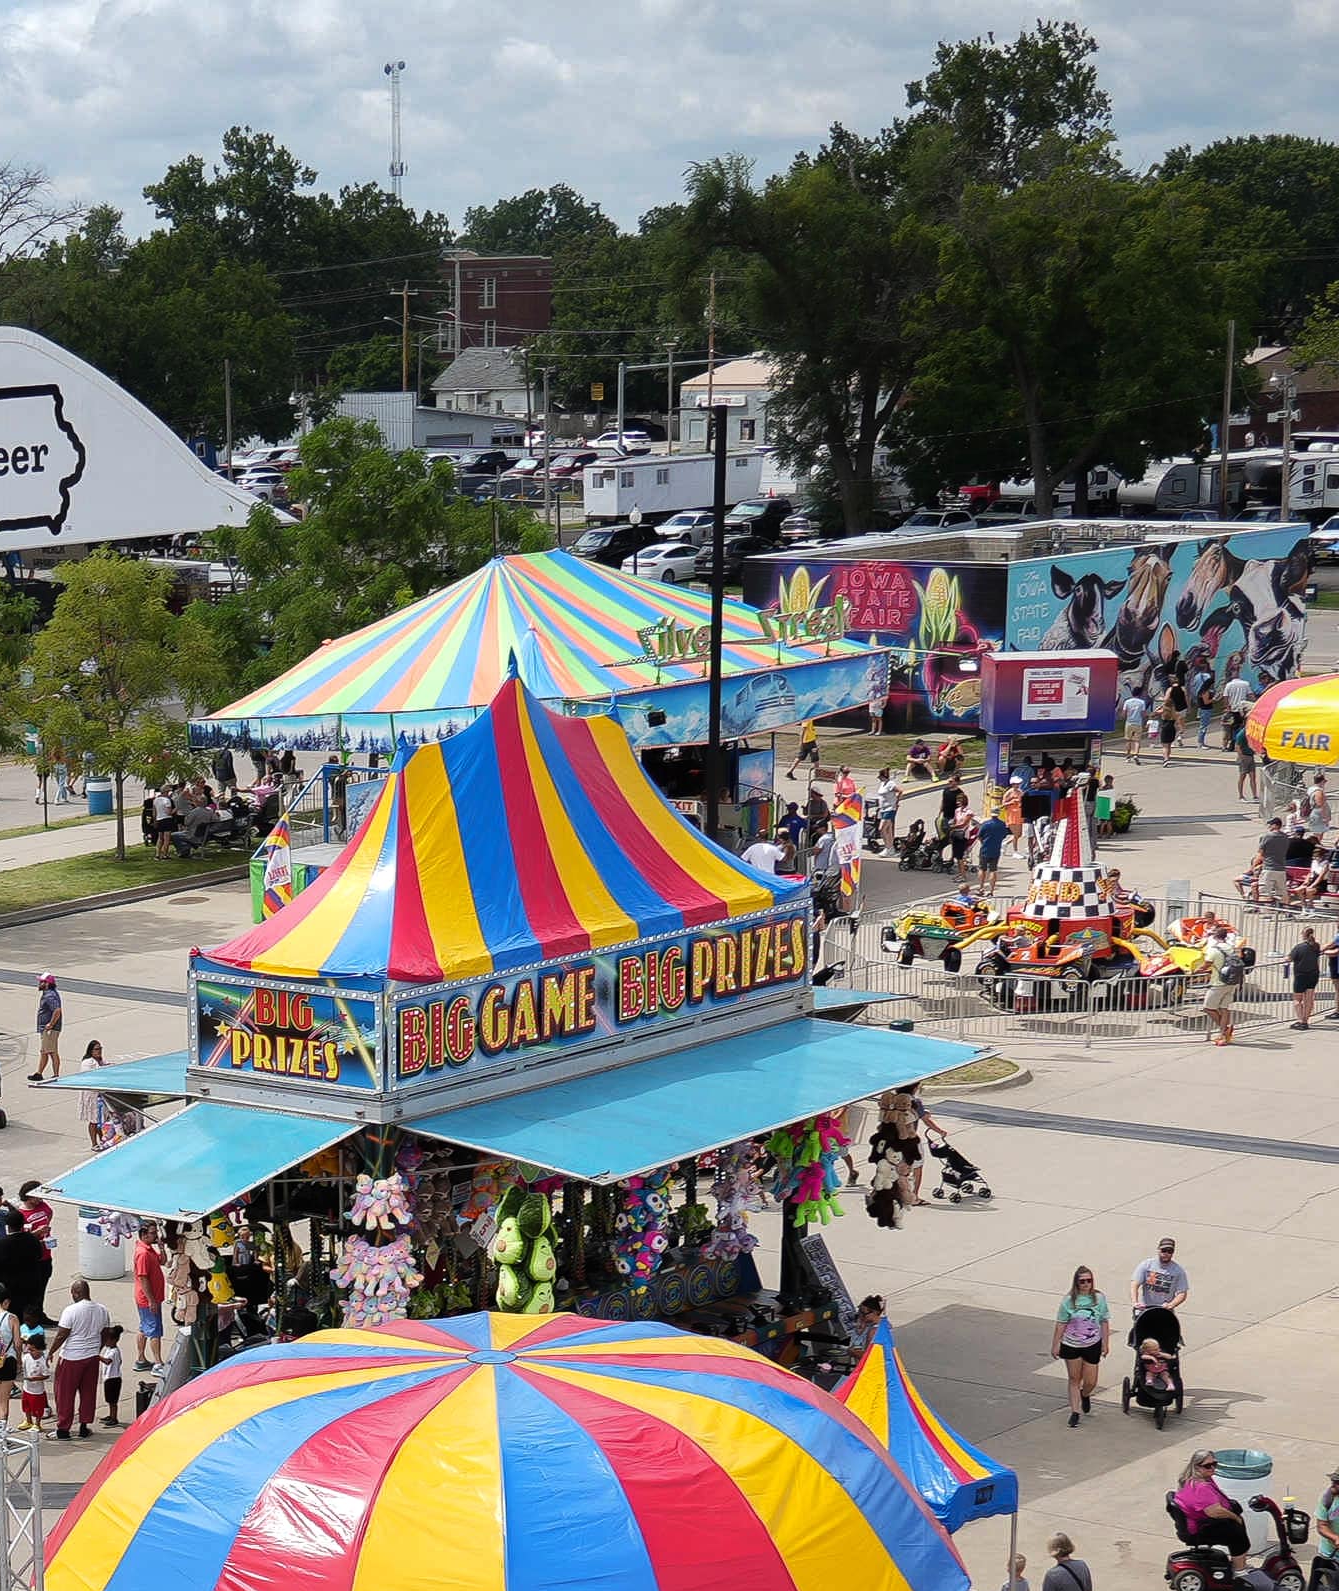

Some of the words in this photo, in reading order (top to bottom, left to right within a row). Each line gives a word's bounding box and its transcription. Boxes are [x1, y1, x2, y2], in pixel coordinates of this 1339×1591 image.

[841, 569, 907, 590] IOWA
[1017, 581, 1047, 599] IOWA
[837, 588, 912, 609] STATE
[849, 608, 903, 625] FAIR
[1011, 603, 1052, 622] STATE
[635, 616, 713, 666] Silve
[1280, 730, 1331, 752] FAIR
[670, 800, 694, 811] XIT
[1020, 950, 1031, 961] 2
[398, 996, 476, 1079] BIG
[479, 964, 598, 1056] GAME
[618, 946, 687, 1025] BIG
[689, 916, 808, 1005] PRIZES
[254, 987, 315, 1031] BIG
[230, 1028, 341, 1082] PRIZES
